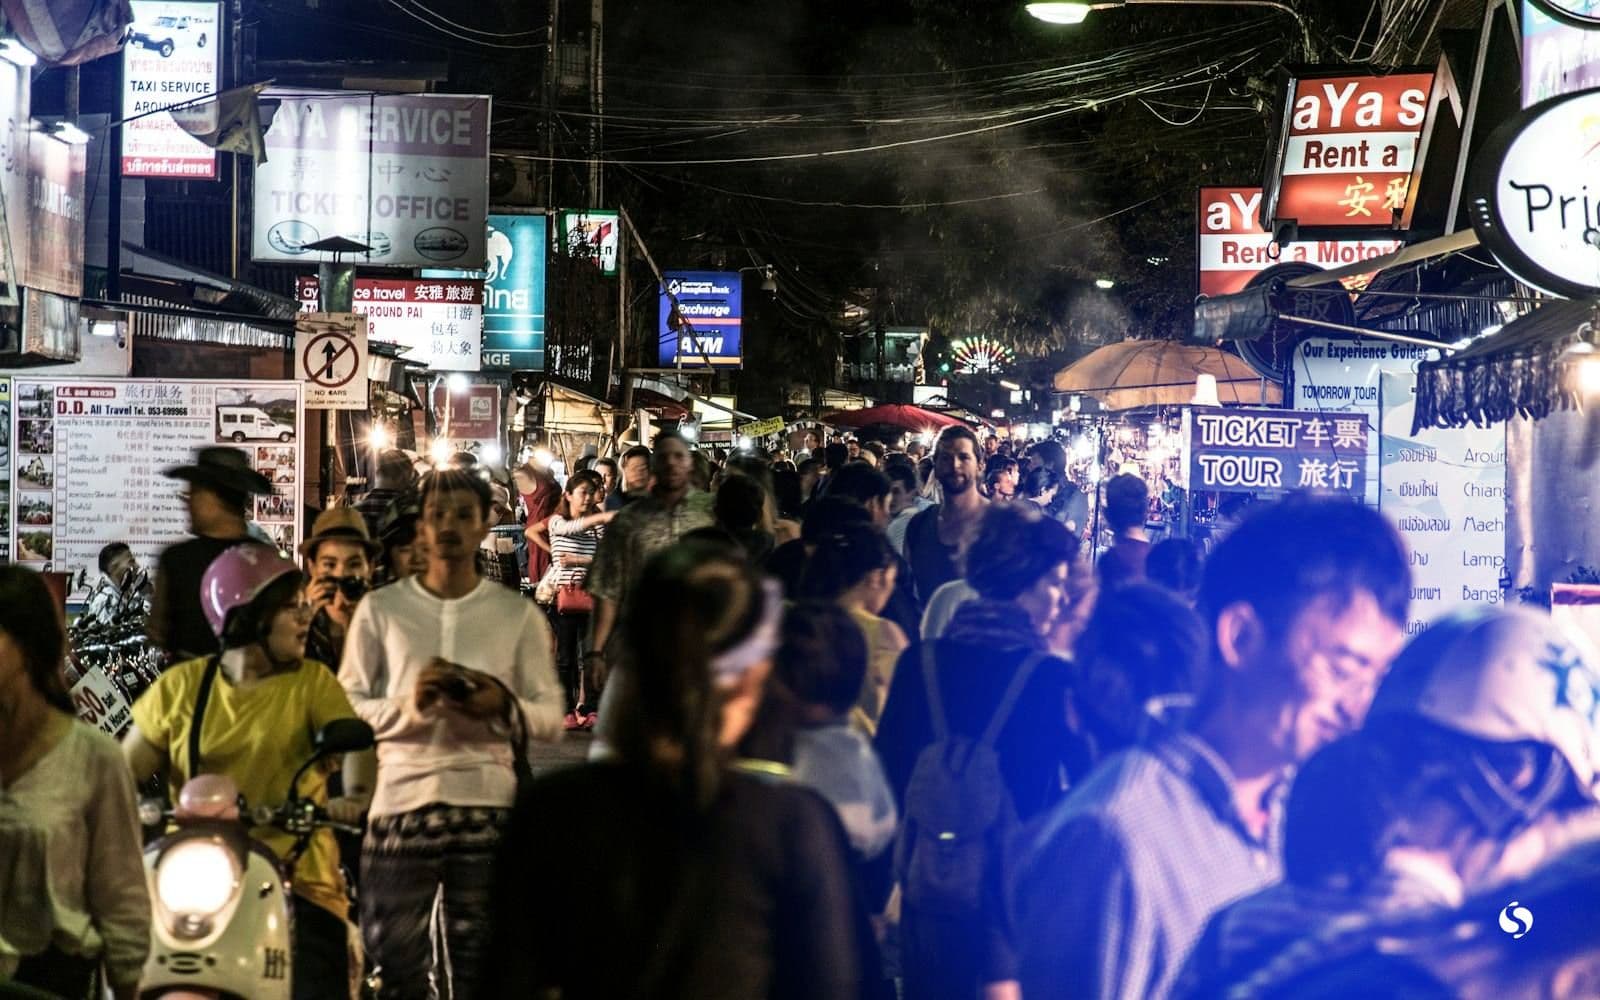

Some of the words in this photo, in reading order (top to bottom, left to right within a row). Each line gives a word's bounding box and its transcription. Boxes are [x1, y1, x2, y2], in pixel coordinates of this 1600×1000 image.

[130, 80, 157, 92] TAXI
[161, 81, 210, 93] SERVICE
[1397, 88, 1425, 127] s
[1303, 140, 1370, 169] Rent
[1382, 144, 1398, 167] a
[375, 194, 469, 221] OFFICE
[1206, 192, 1263, 231] aY
[1294, 245, 1308, 263] a
[1317, 241, 1402, 263] Motor
[373, 287, 406, 300] travel
[363, 306, 403, 318] AROUND
[407, 306, 423, 318] PAI
[679, 303, 730, 317] Exchange
[1303, 341, 1326, 358] Our
[1327, 341, 1387, 362] Experience
[1302, 385, 1352, 400] TOMORROW
[1354, 385, 1377, 401] TOUR
[57, 400, 89, 415] D.D.
[90, 404, 102, 415] All
[106, 404, 132, 416] Travel
[1197, 414, 1302, 448] TICKET
[1302, 417, 1367, 449] 车票
[1199, 455, 1282, 487] TOUR
[1298, 457, 1359, 489] 旅行
[1463, 517, 1504, 532] Maeh
[1463, 550, 1505, 569] Lamp
[1462, 585, 1505, 604] Bangk
